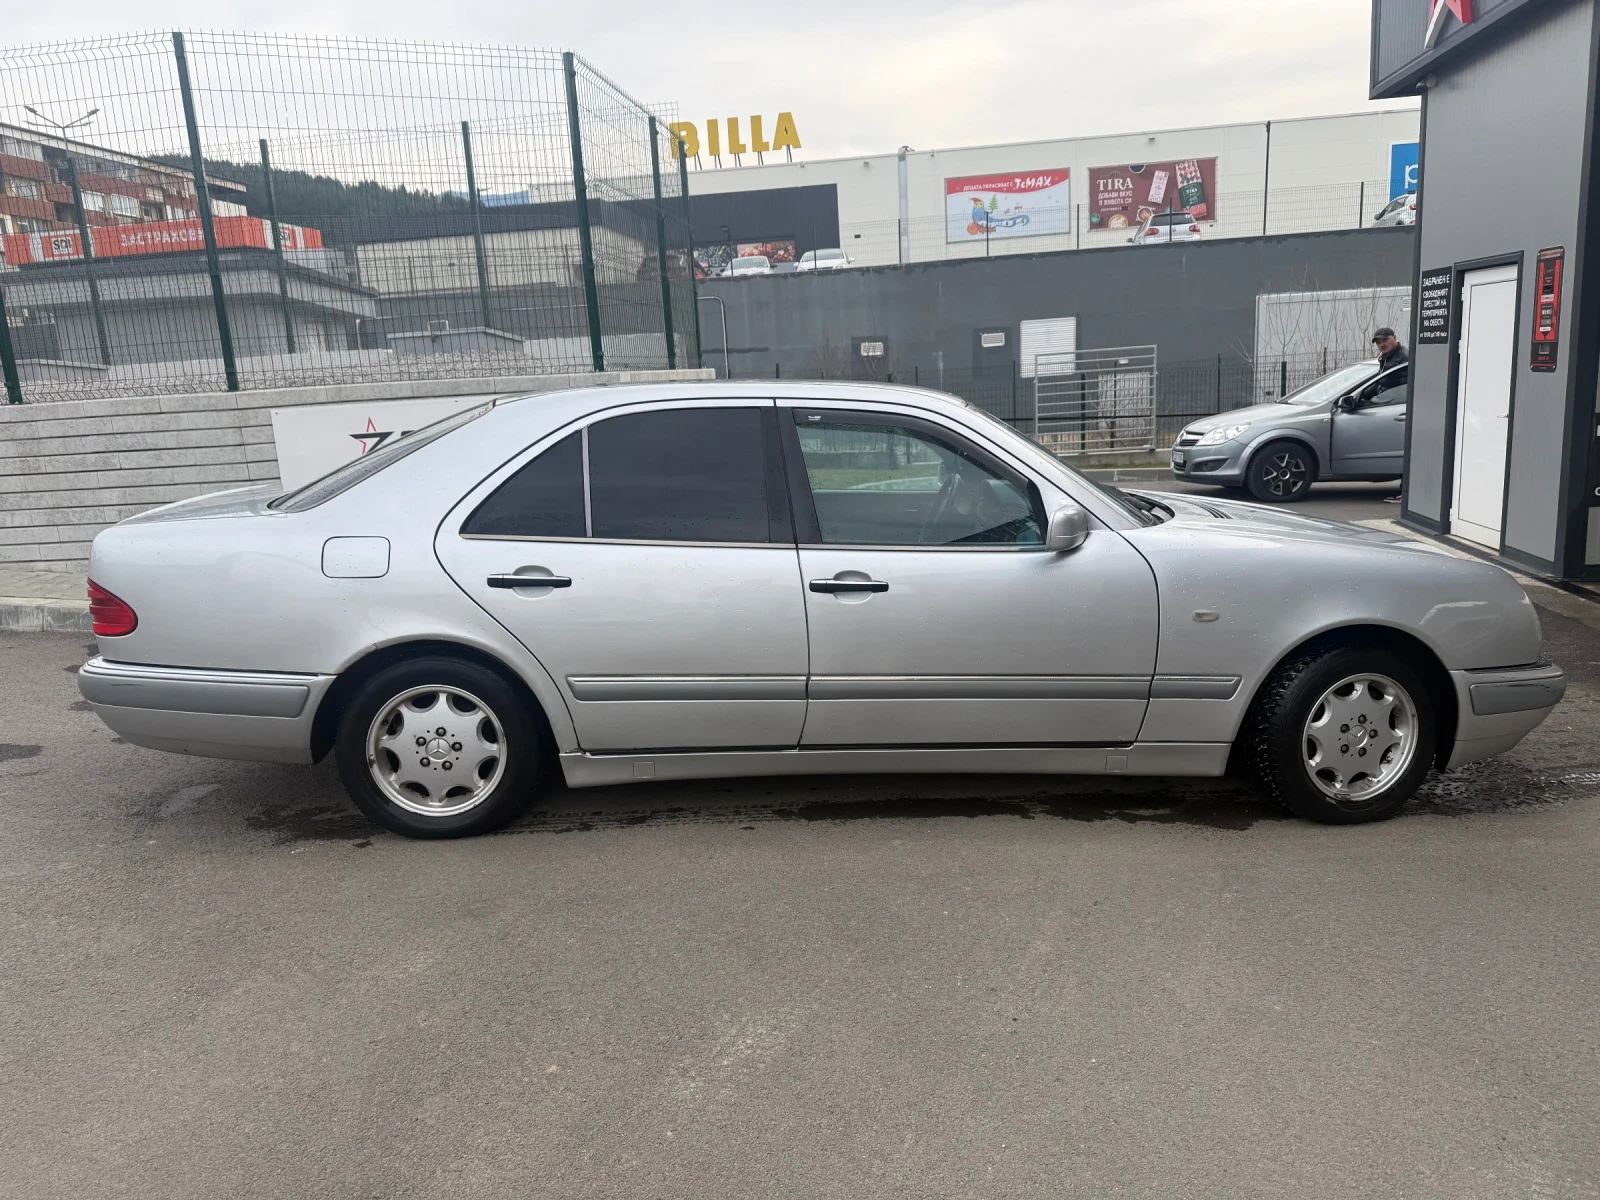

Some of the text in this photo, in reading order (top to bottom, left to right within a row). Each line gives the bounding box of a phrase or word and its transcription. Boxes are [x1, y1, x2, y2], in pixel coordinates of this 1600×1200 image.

[669, 112, 802, 159] BILLA
[963, 184, 983, 192] ДЕЦАТА
[1097, 177, 1134, 191] TIRA
[1098, 190, 1132, 200] ДОБАВИ ВКУС
[1104, 198, 1124, 206] ЖИВОТА
[1423, 274, 1450, 287] ЗАБРАНЕН Е
[1424, 297, 1447, 307] ПРЕСТОЙ НА
[1421, 308, 1447, 318] ТЕРИТОРИЯТА
[1430, 317, 1444, 326] ОБЕКТА
